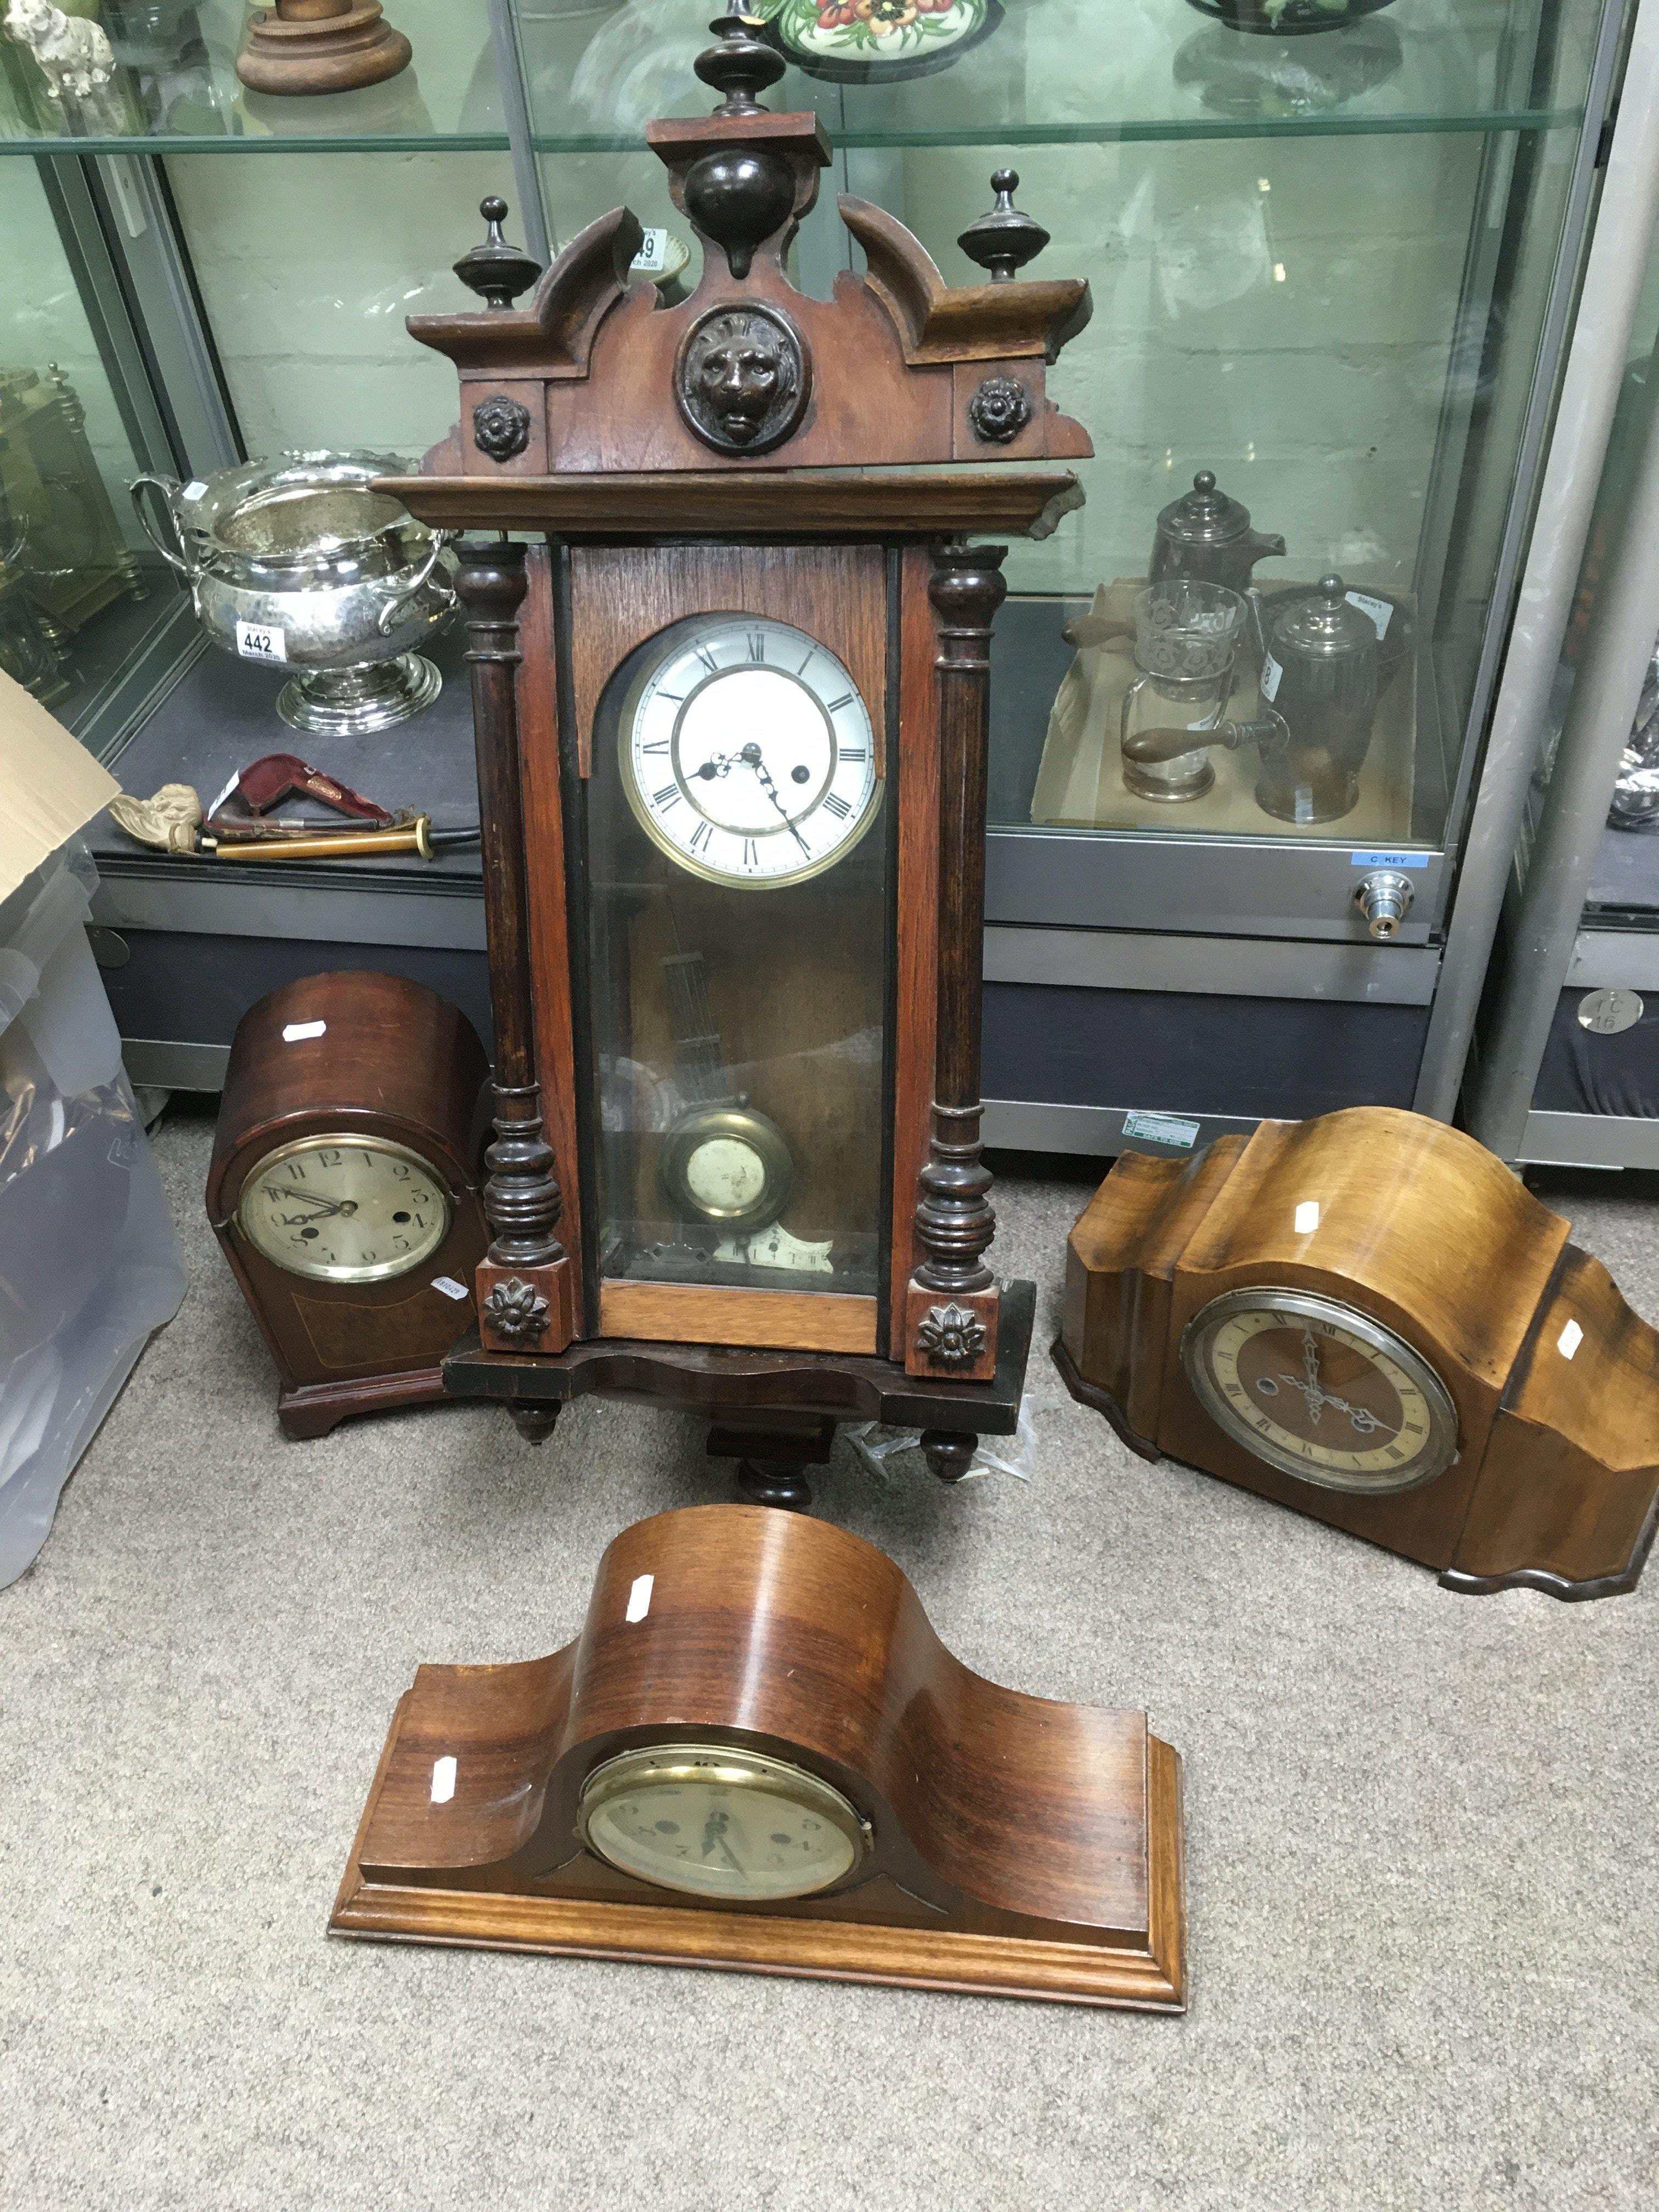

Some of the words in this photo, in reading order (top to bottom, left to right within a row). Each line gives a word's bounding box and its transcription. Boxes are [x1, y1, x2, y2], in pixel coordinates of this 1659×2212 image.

[244, 633, 272, 653] 442
[318, 1150, 343, 1168] 12
[393, 1165, 411, 1182] 2
[411, 1188, 430, 1204] 3
[392, 1234, 410, 1249] 5
